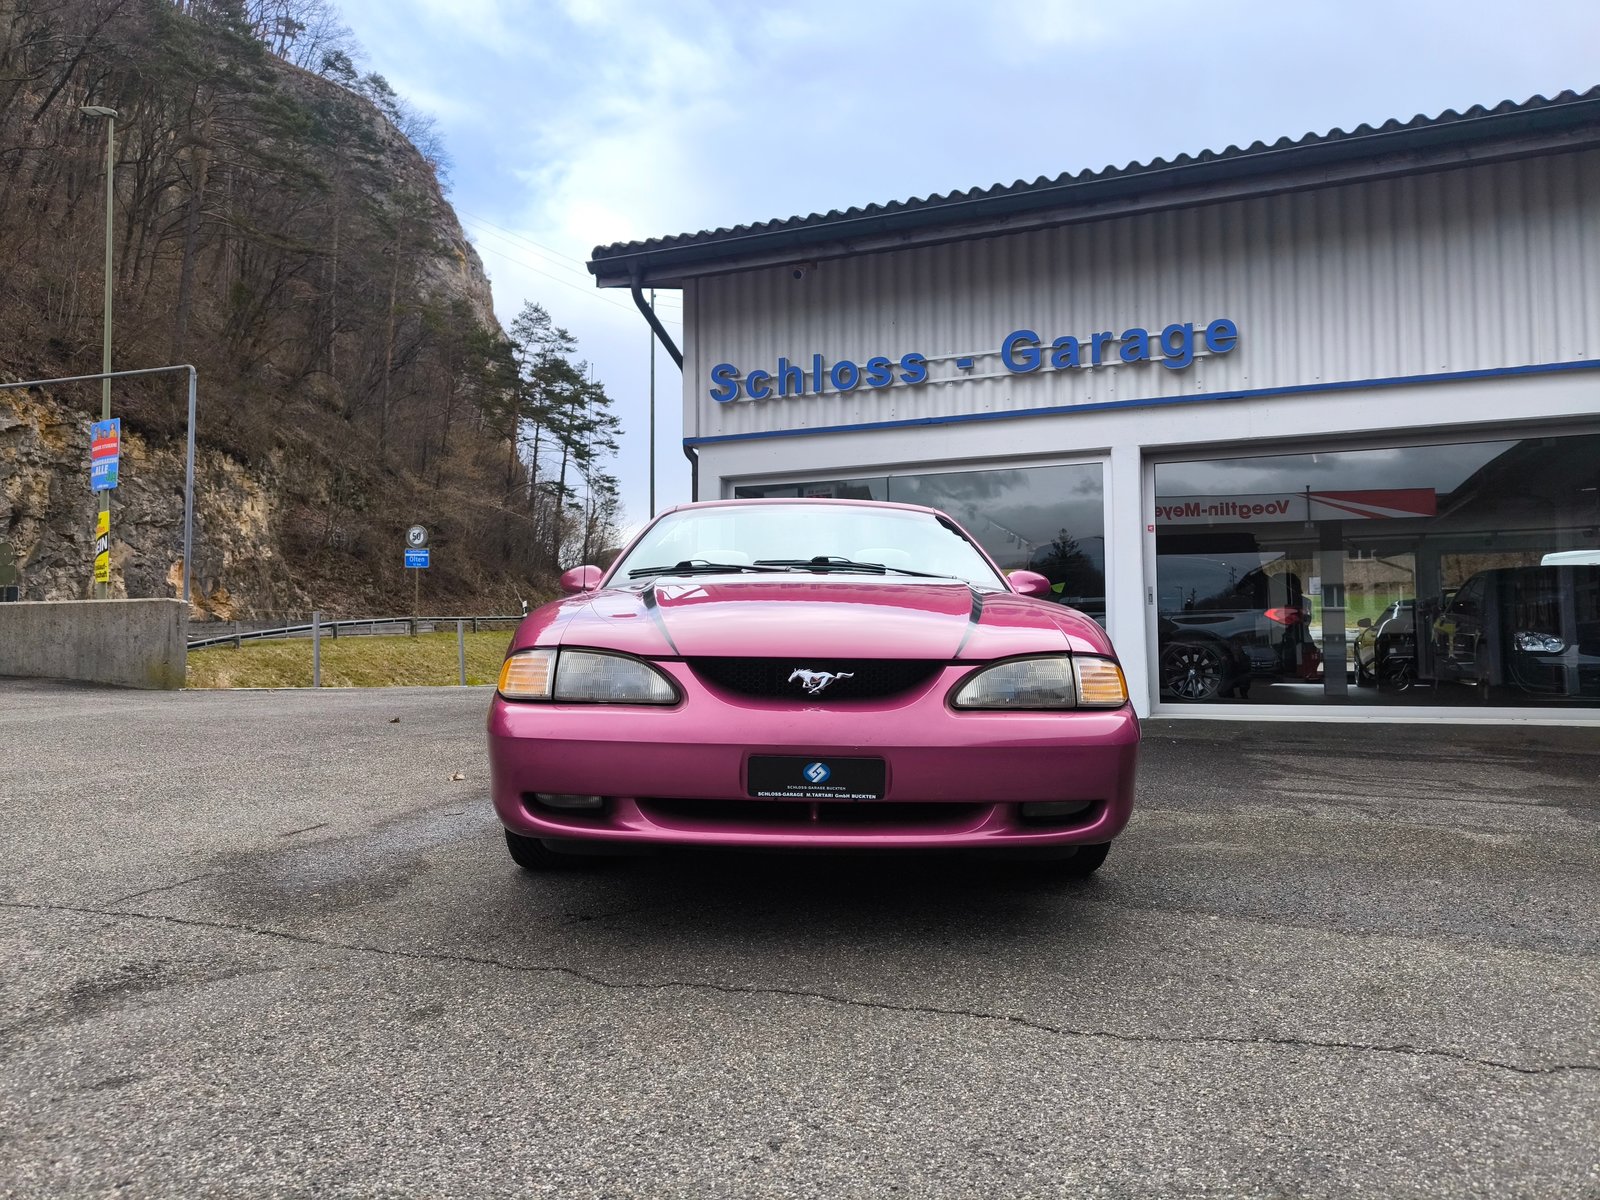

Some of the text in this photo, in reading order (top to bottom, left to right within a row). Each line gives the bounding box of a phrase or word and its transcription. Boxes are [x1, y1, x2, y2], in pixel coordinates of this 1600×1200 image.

[710, 318, 1238, 403] Schloss - Garage
[412, 532, 421, 541] 50
[410, 555, 425, 563] Olten
